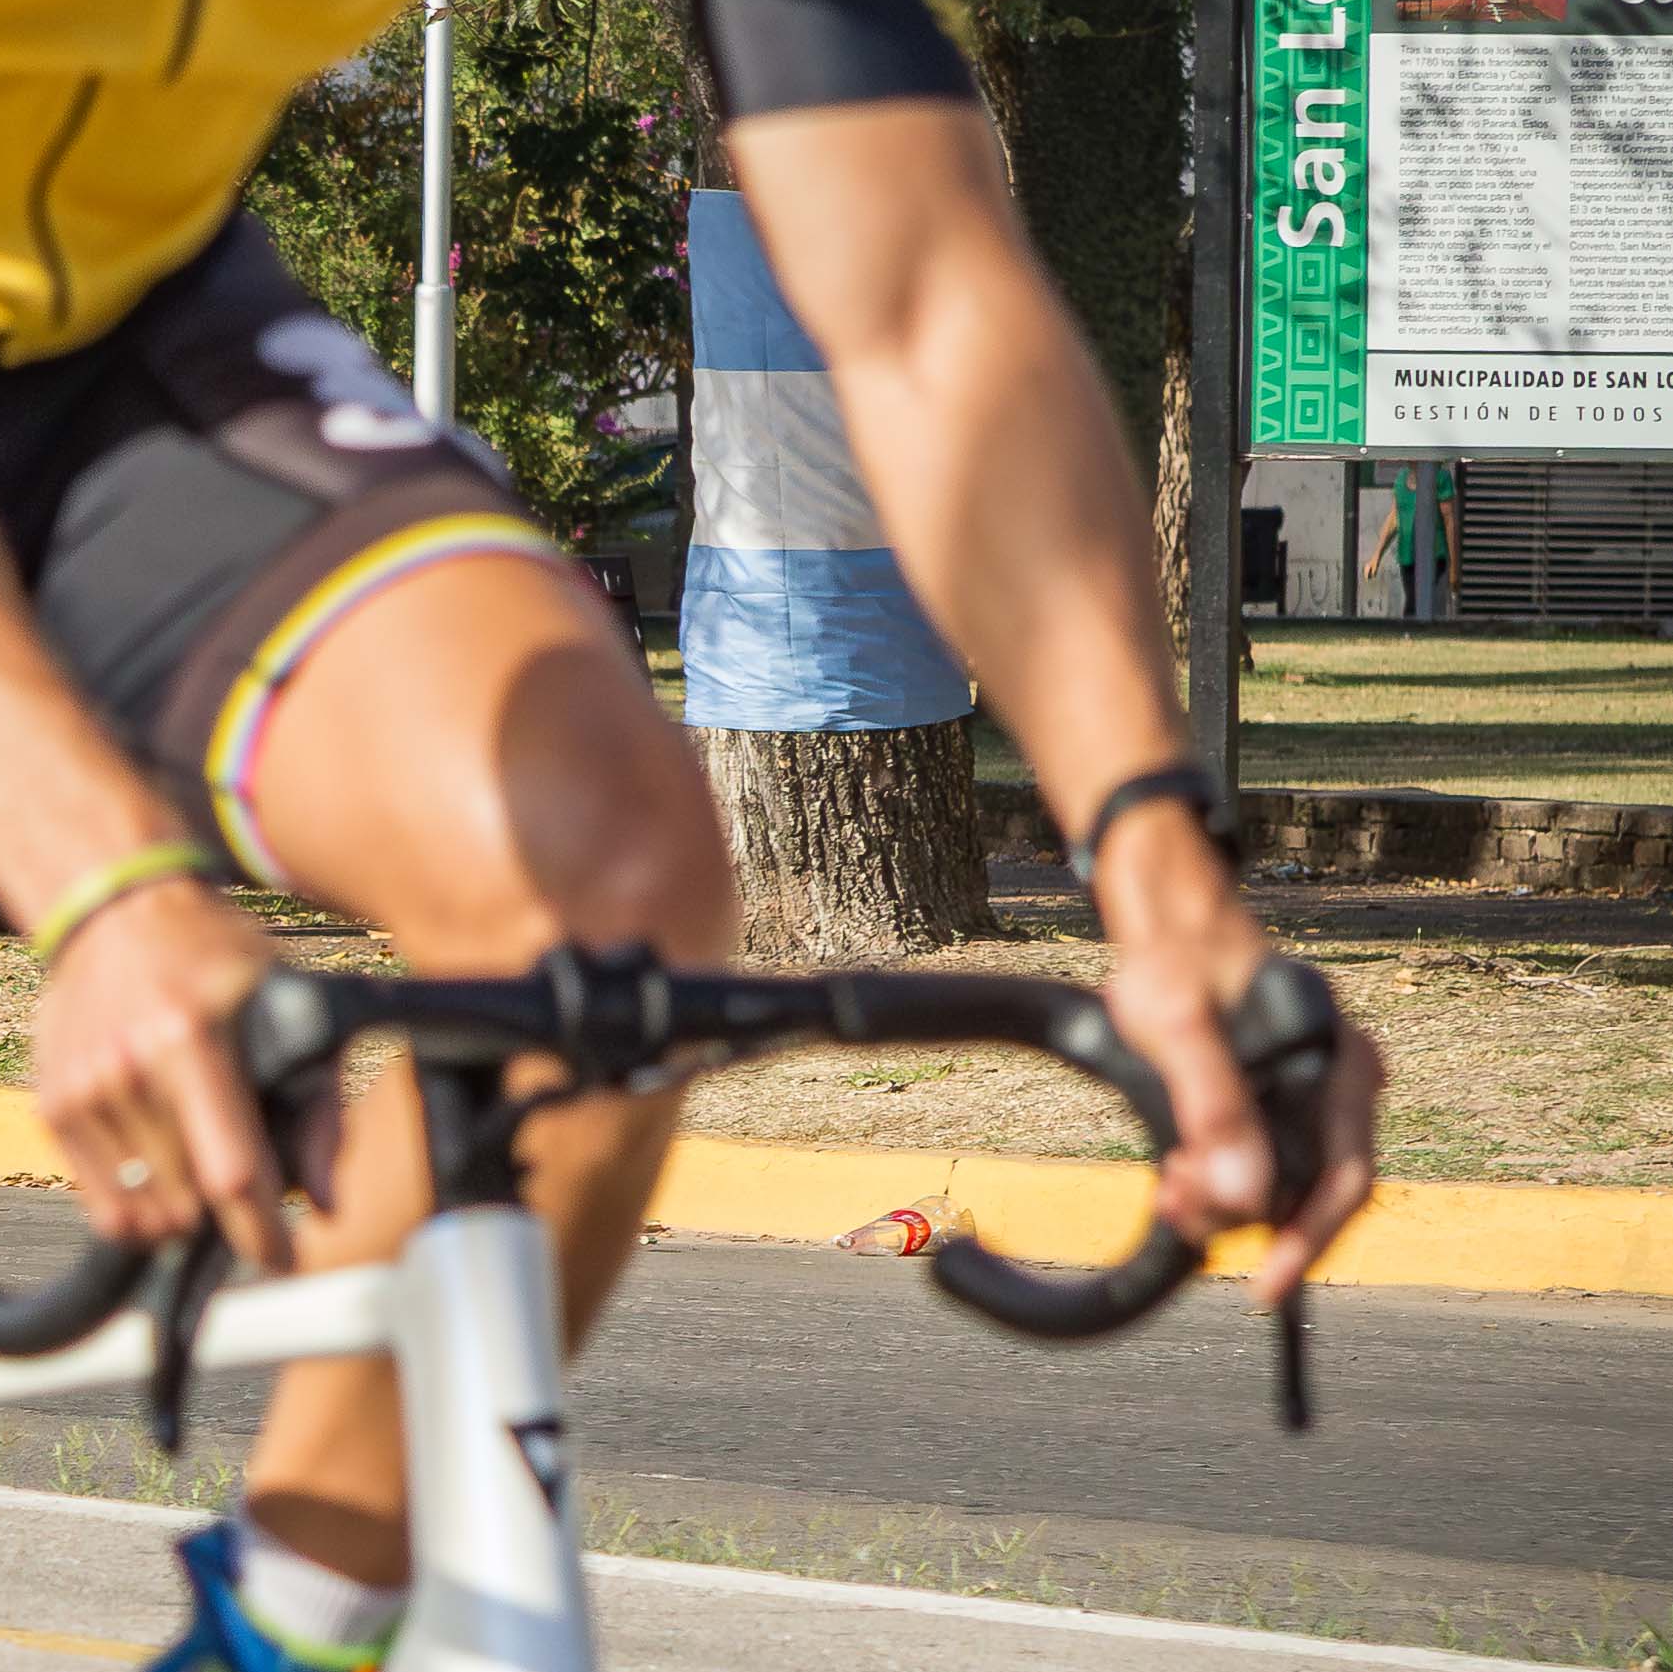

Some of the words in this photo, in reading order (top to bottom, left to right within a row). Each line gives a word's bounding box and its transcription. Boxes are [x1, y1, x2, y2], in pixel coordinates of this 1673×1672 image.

[1278, 88, 1346, 248] San
[1394, 369, 1564, 388] MUNICIPALIDAD
[1573, 370, 1597, 388] DE
[1605, 371, 1647, 389] SAN
[1394, 402, 1509, 420] GESTIÓN
[1529, 405, 1557, 421] DE
[1576, 406, 1662, 422] TODOS
